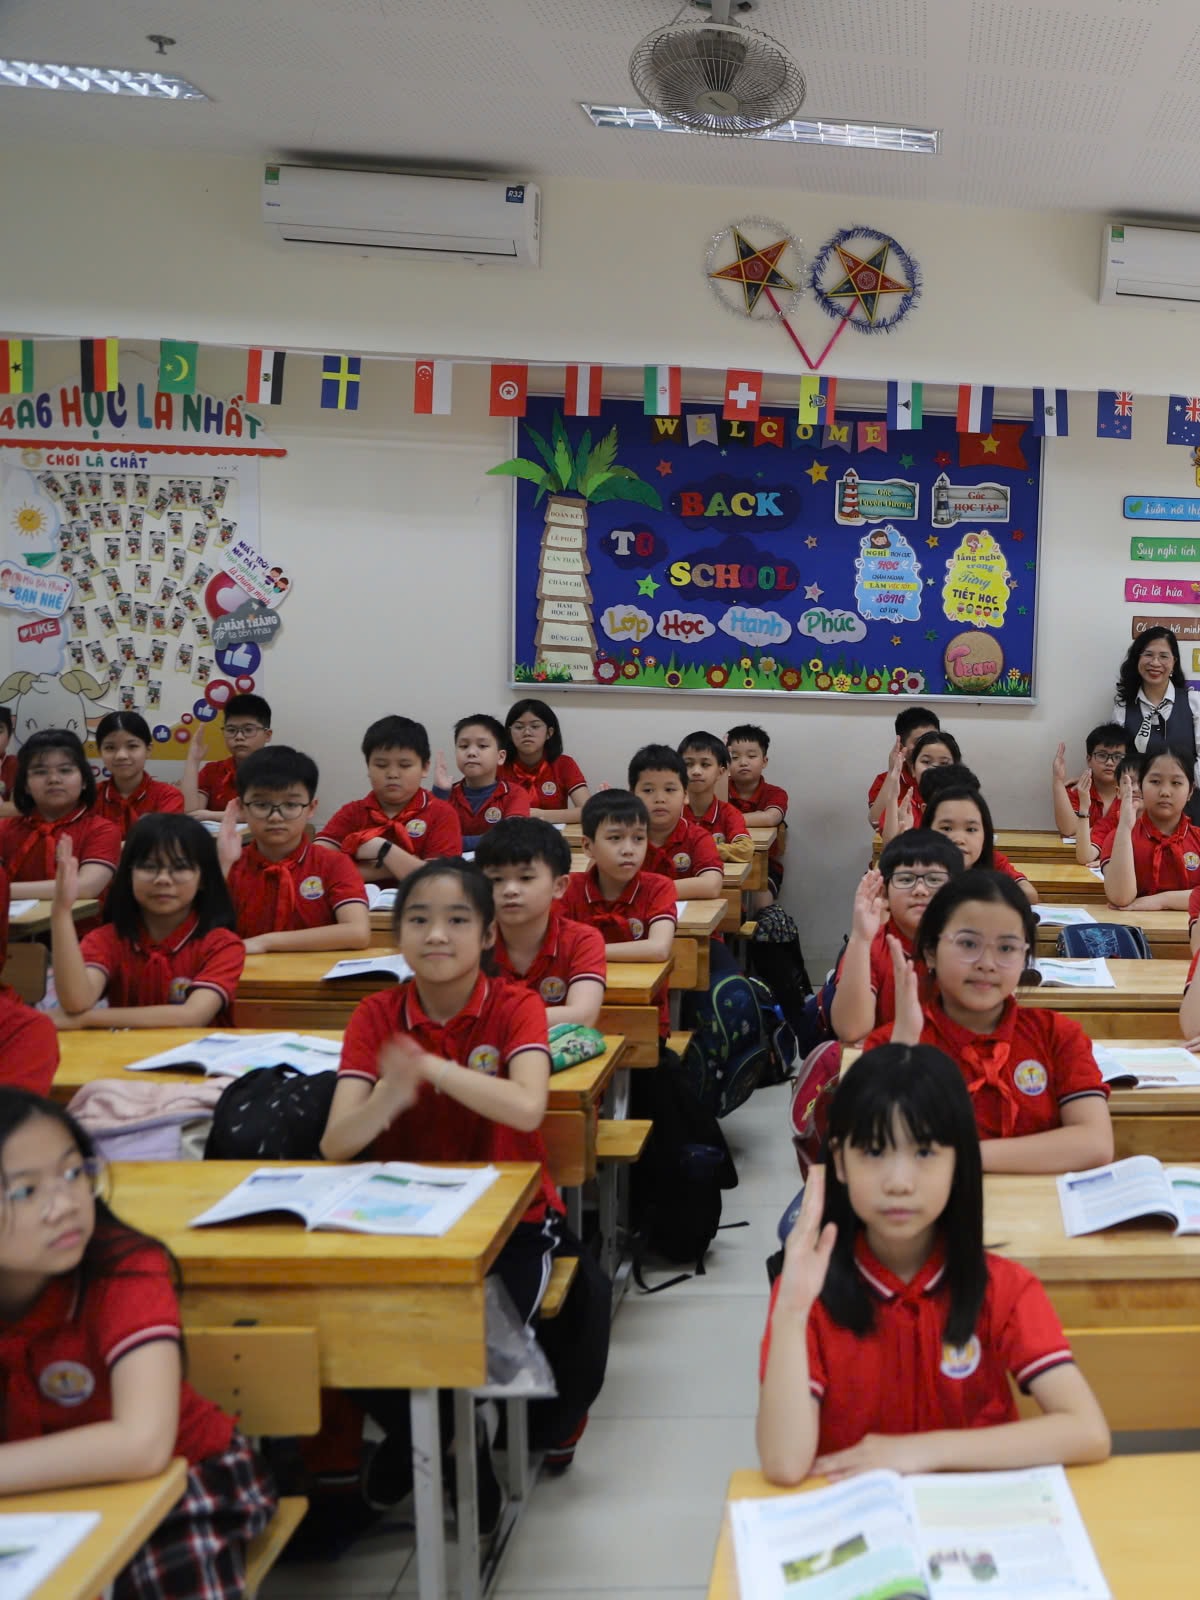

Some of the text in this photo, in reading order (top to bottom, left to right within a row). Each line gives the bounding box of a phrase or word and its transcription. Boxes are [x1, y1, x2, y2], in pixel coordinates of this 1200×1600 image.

[60, 383, 128, 440] HỌC
[182, 394, 262, 439] NHẤT
[655, 418, 882, 443] WELCOME
[46, 452, 149, 469] CHƠI LÀ CHẤT
[680, 492, 784, 517] BACK
[954, 503, 1000, 514] HỌC TẬP
[610, 530, 655, 557] TO
[1136, 543, 1153, 557] Suy
[1157, 543, 1177, 558] nghĩ
[1181, 544, 1196, 557] tích
[978, 554, 1000, 562] nghe
[669, 561, 798, 591] SCHOOL
[952, 587, 998, 605] TIẾT HỌC
[1132, 583, 1147, 599] Giữ
[1165, 585, 1183, 597] hứa
[30, 620, 57, 636] LIKE
[608, 610, 649, 641] Lớp
[663, 613, 705, 639] Học
[804, 610, 857, 633] Phúc
[946, 644, 997, 677] Team
